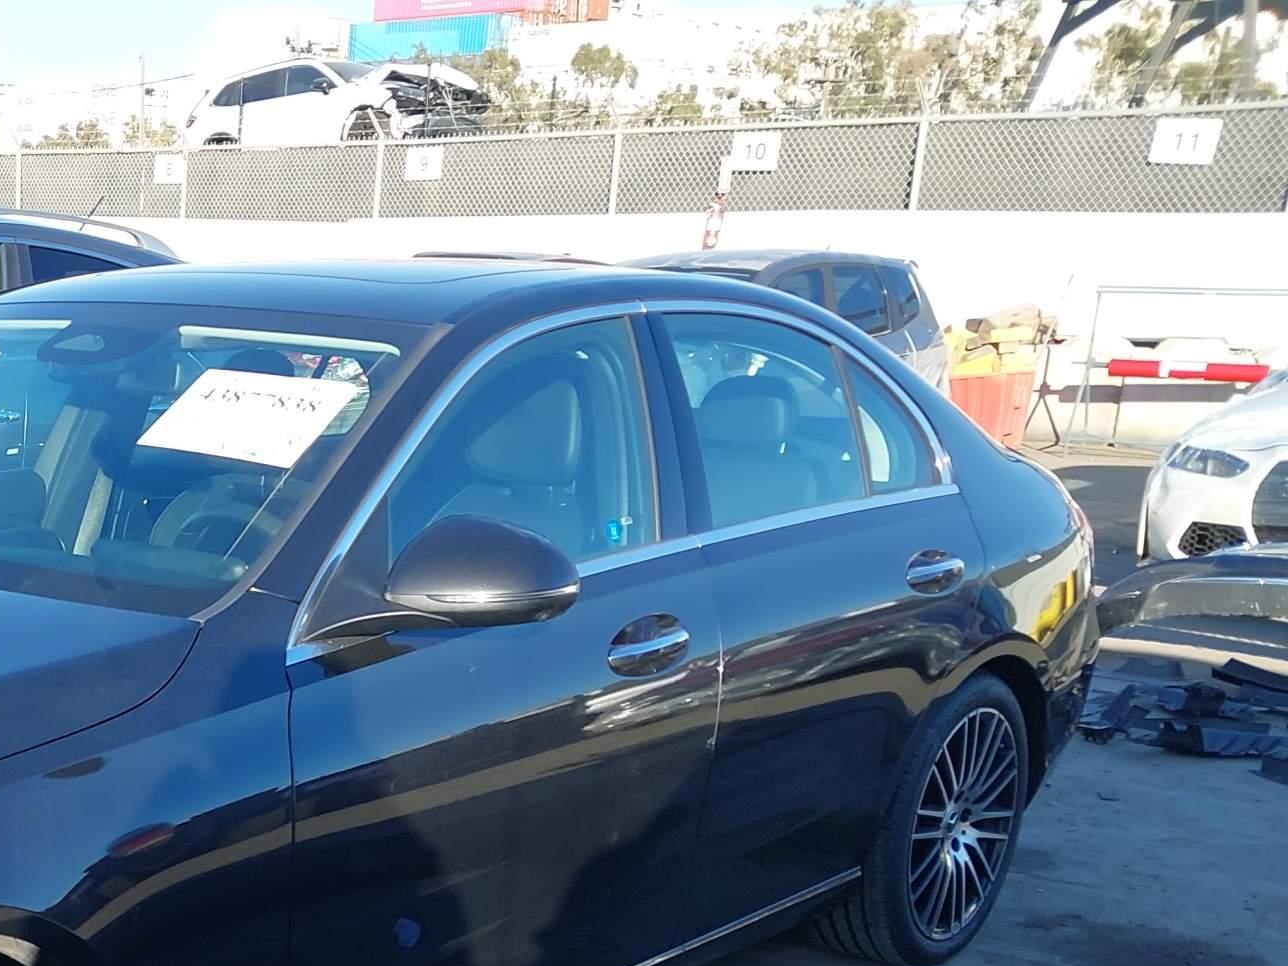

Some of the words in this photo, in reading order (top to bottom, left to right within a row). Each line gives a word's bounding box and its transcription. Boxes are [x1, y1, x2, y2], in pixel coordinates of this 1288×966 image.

[1176, 132, 1200, 152] 11
[745, 143, 766, 160] 10
[420, 155, 428, 172] 9
